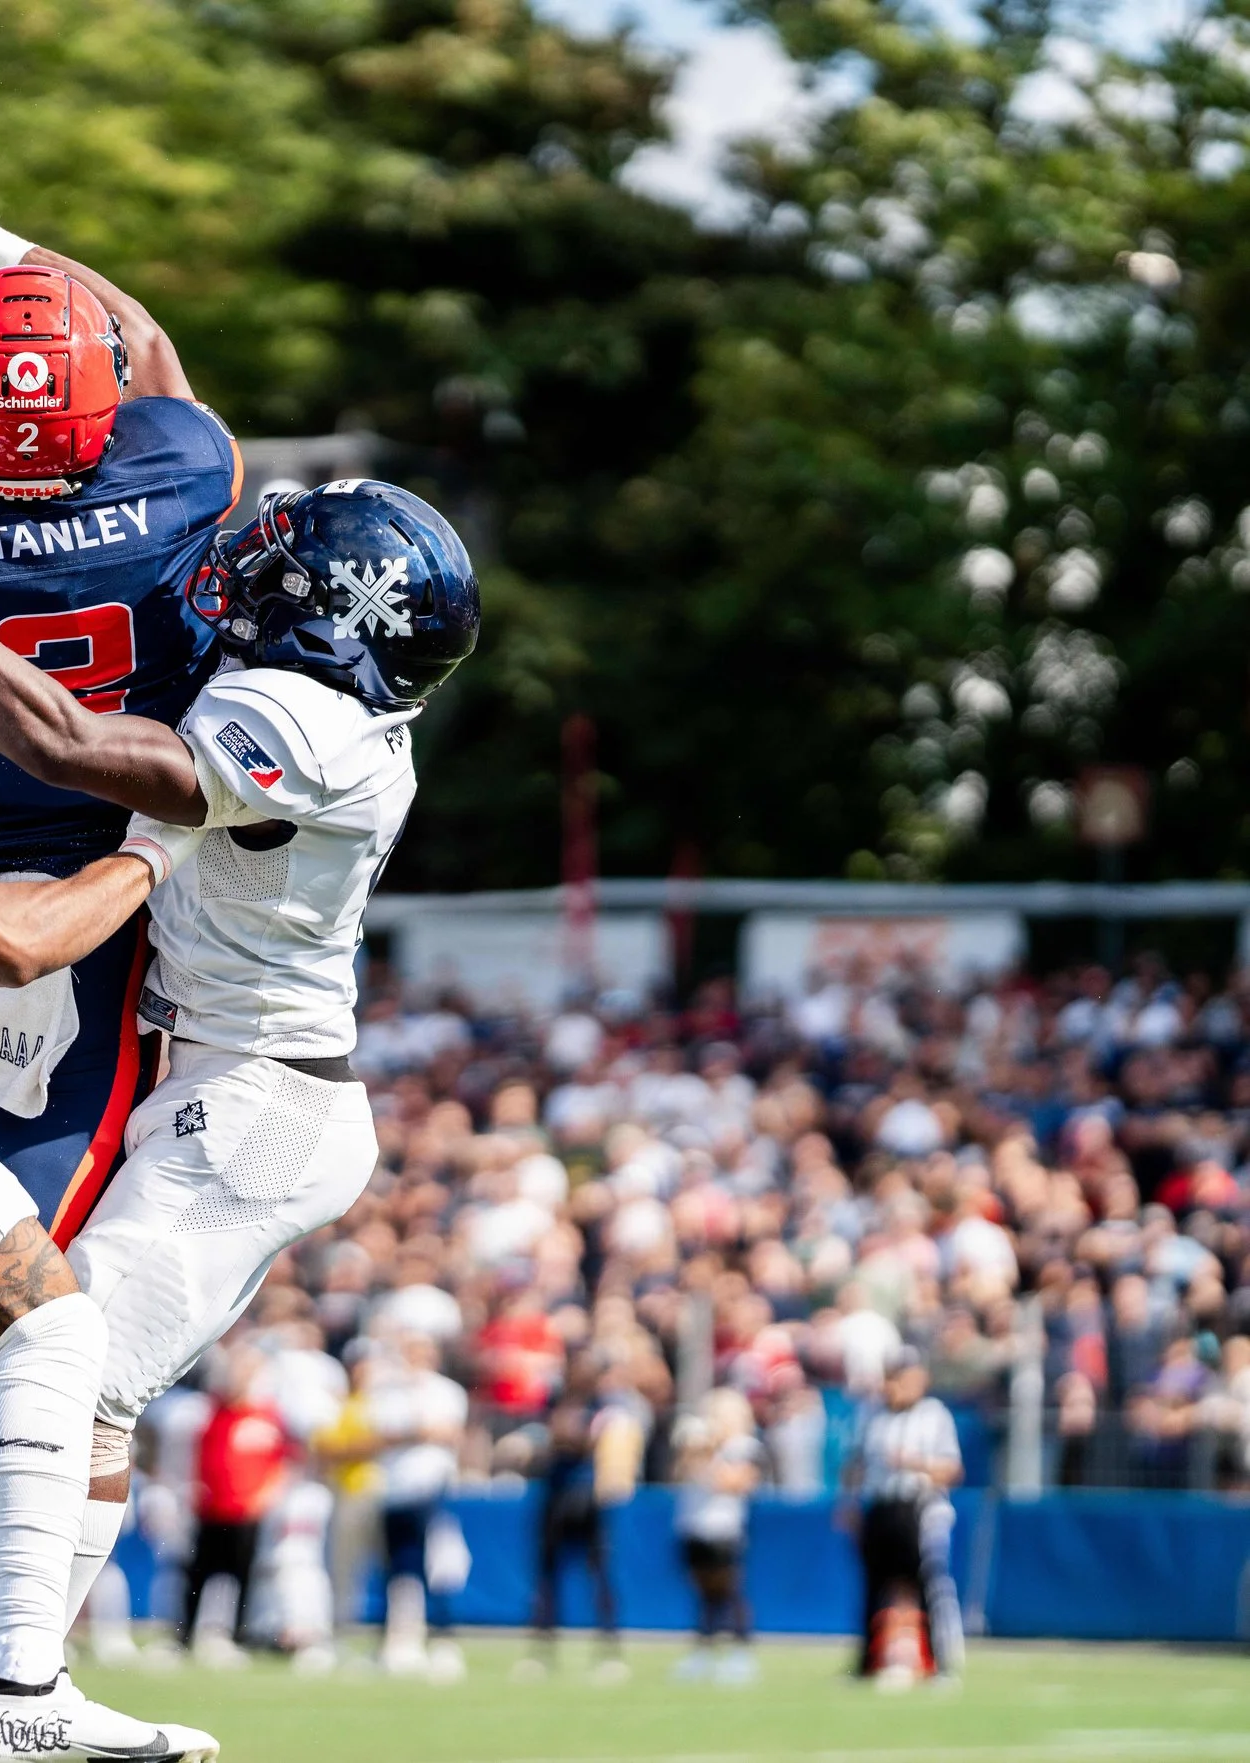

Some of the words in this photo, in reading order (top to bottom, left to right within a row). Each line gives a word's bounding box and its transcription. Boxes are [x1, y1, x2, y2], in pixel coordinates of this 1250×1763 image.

[16, 422, 39, 452] 2
[218, 732, 245, 760] FOOTBALL
[223, 728, 245, 750] LEAGUE
[229, 723, 257, 753] EUROPEAN
